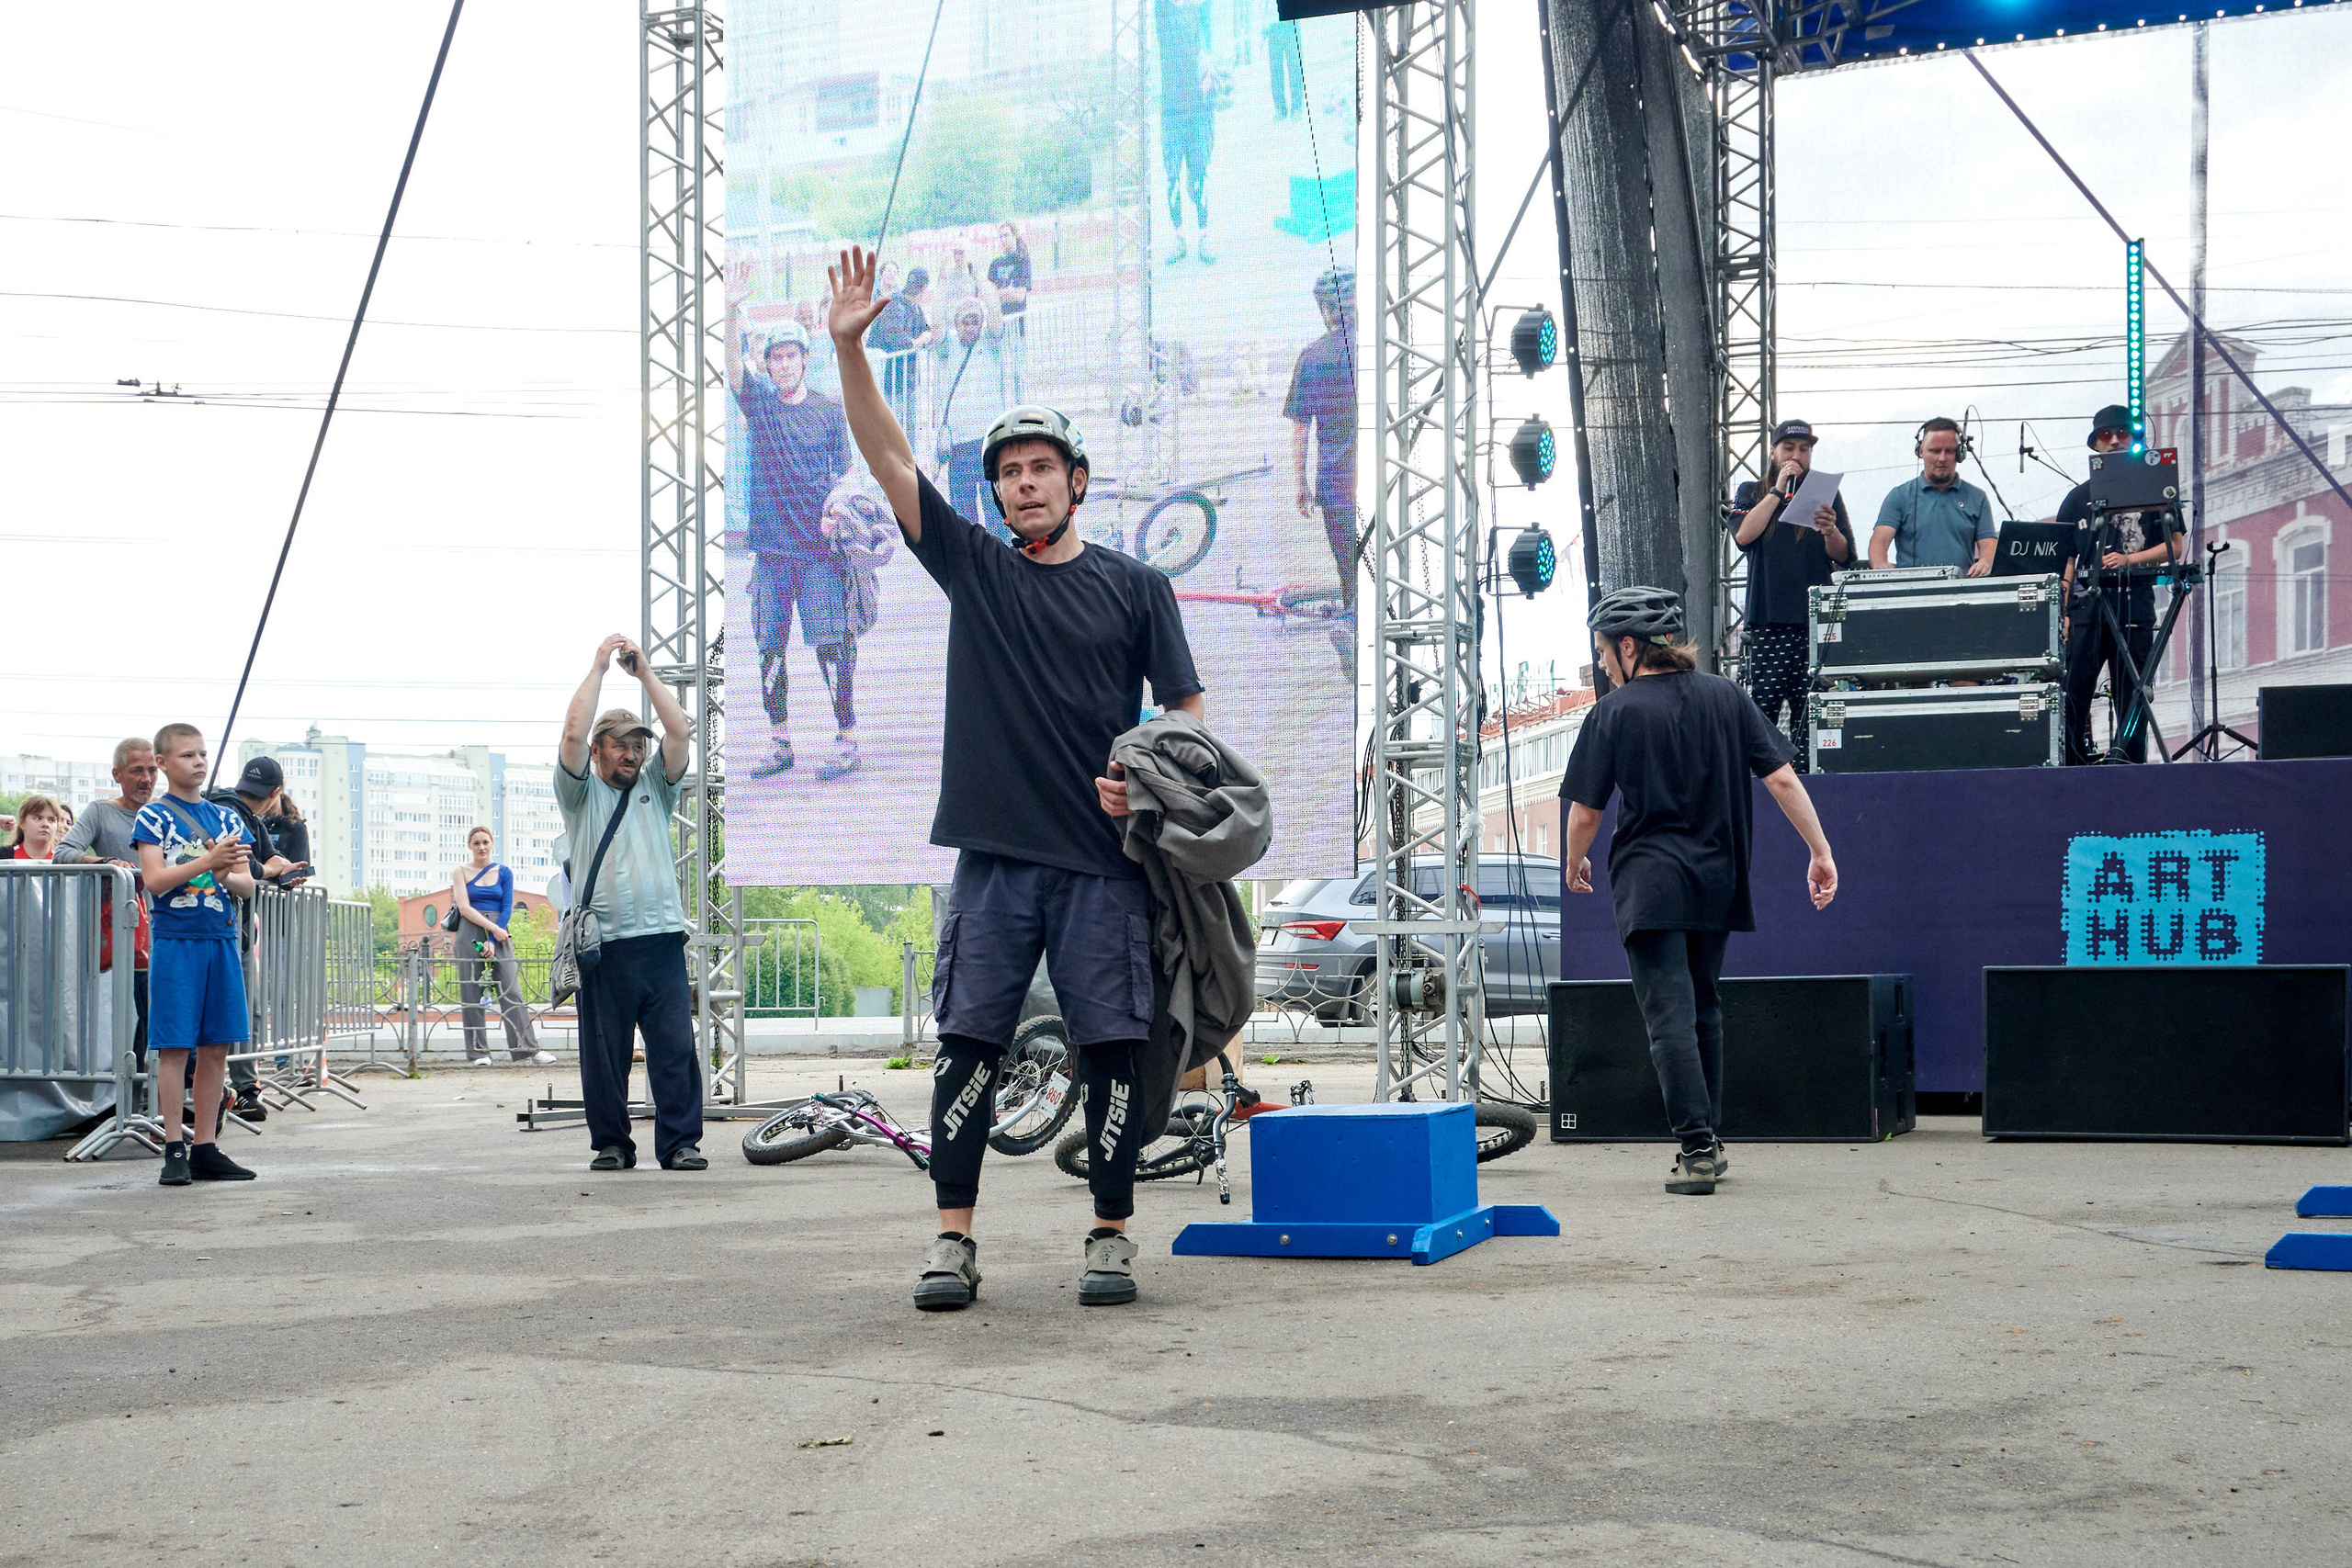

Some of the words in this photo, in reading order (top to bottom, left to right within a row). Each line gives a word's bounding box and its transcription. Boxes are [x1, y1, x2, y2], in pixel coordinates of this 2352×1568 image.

[2010, 540, 2030, 556] DJ
[2033, 540, 2058, 557] NIK
[1823, 739, 1837, 748] 226
[2086, 850, 2240, 903] ART
[2086, 908, 2243, 962] HUB
[1046, 1087, 1062, 1106] 860
